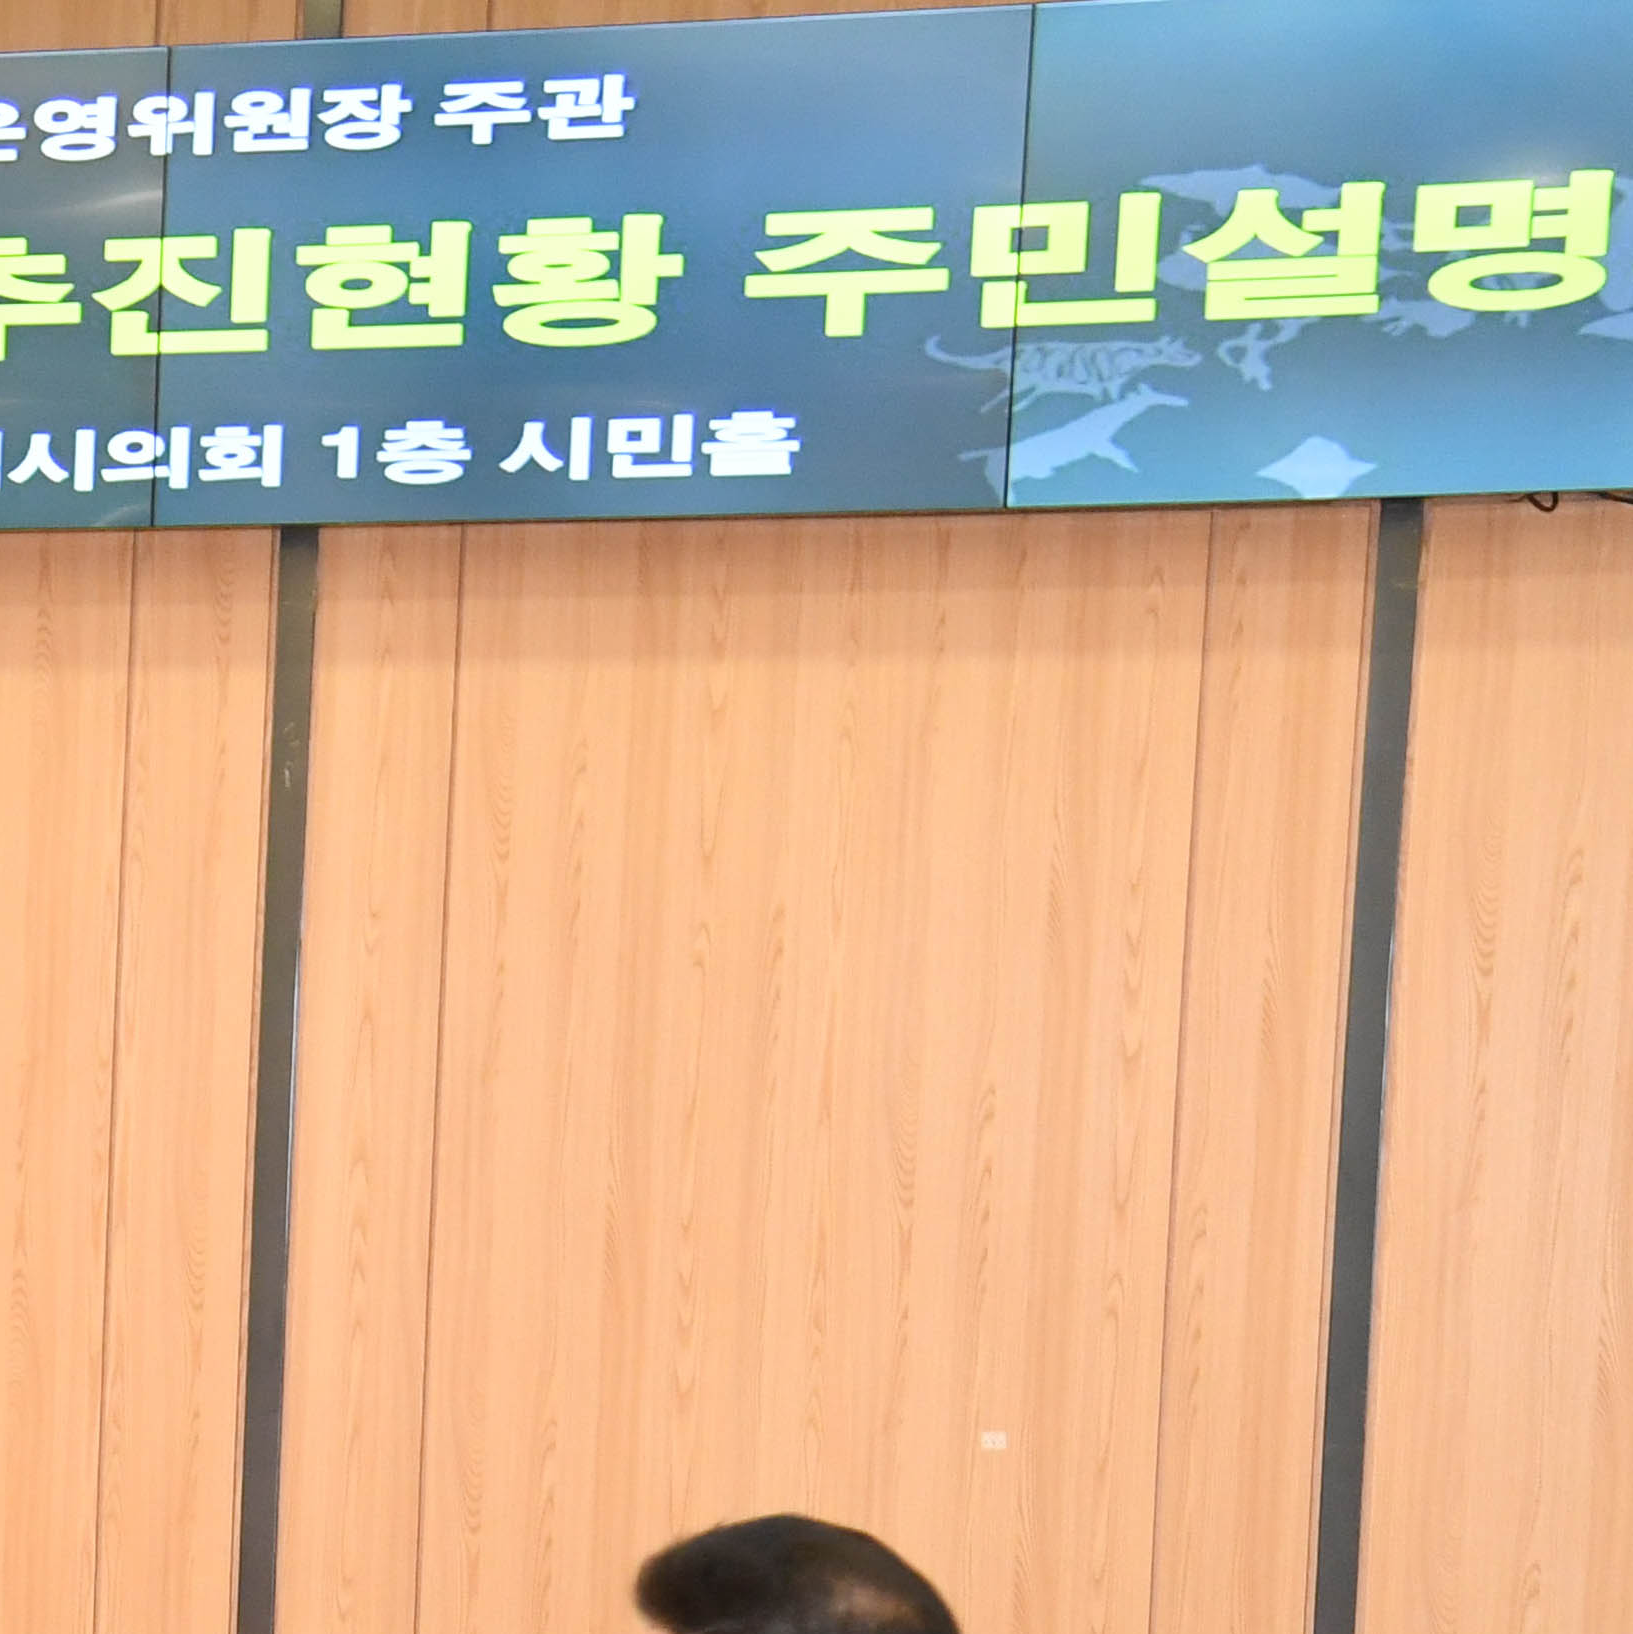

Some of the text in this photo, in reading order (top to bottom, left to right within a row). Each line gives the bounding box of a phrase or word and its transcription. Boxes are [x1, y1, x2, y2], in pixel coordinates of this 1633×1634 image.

[434, 73, 635, 146] 주관
[743, 168, 1615, 338] 주민설명
[321, 420, 472, 485] 1층
[499, 410, 800, 481] 시민홀
